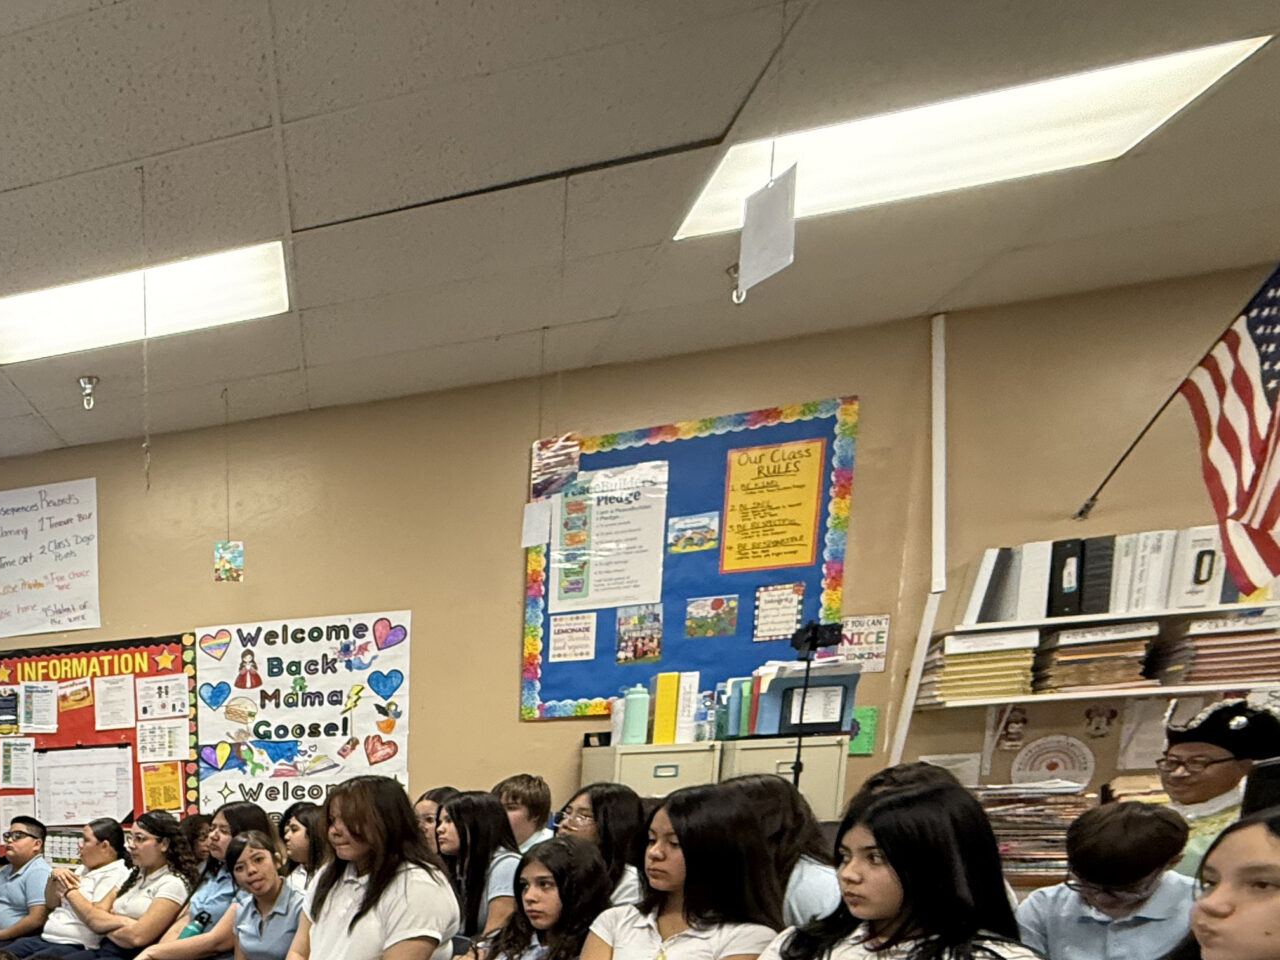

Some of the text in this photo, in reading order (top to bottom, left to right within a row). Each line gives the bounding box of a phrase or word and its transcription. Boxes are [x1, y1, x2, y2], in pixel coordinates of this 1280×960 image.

[737, 447, 812, 466] Our Class
[756, 461, 801, 478] RULES
[236, 622, 369, 648] Welcome
[841, 630, 885, 646] NICE
[16, 651, 149, 682] INFORMATION
[267, 653, 339, 677] Back
[259, 687, 343, 709] Mama
[253, 716, 349, 740] Goose!
[238, 780, 340, 803] Welco
